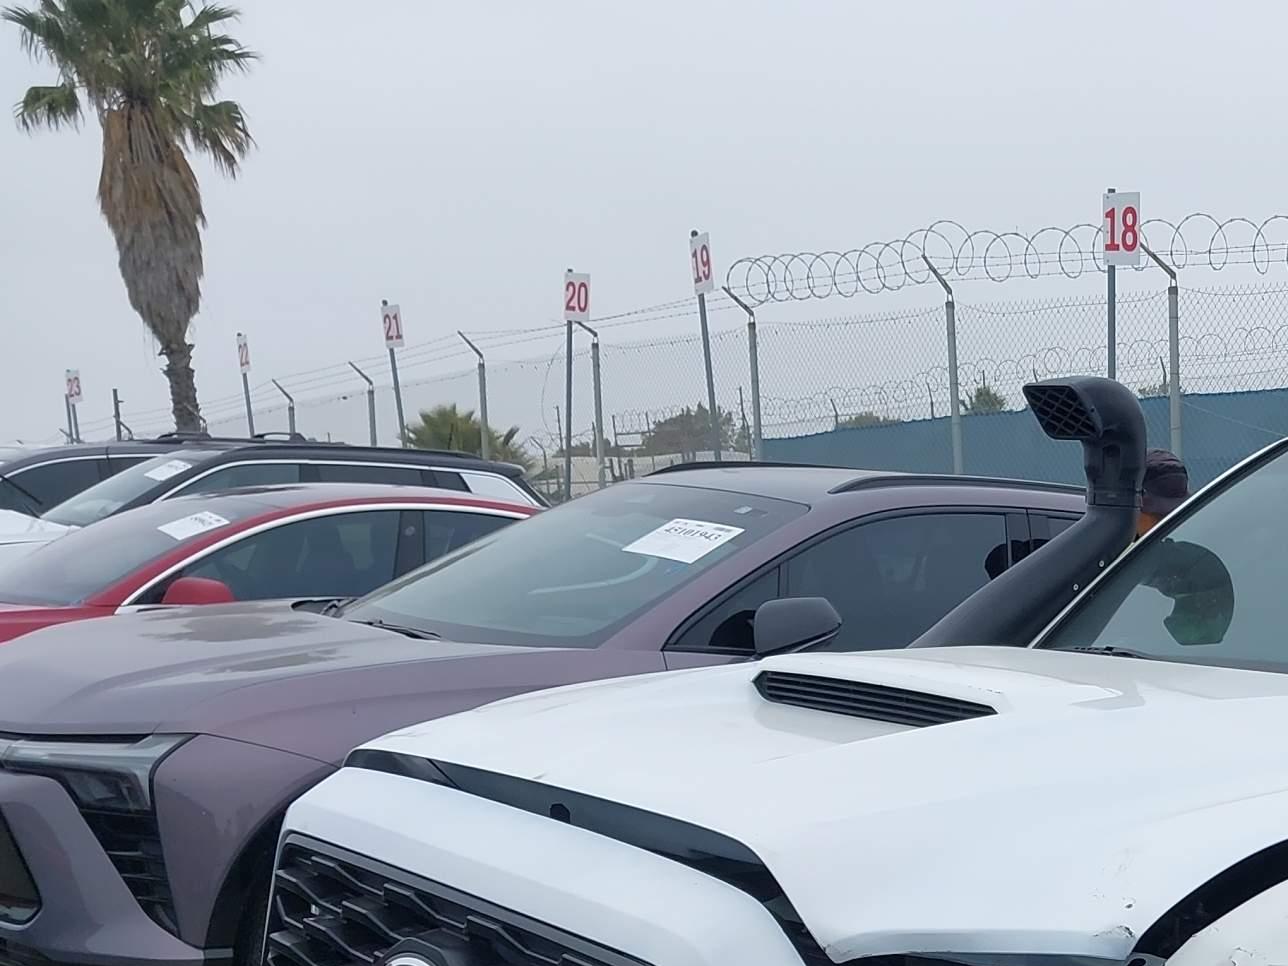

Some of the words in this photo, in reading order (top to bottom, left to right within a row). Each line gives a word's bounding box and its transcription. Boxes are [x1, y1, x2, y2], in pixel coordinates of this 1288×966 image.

[1104, 206, 1138, 252] 18
[691, 244, 711, 284] 19
[565, 281, 589, 313] 20
[383, 313, 402, 341] 21
[238, 343, 250, 367] 22
[67, 376, 82, 398] 23
